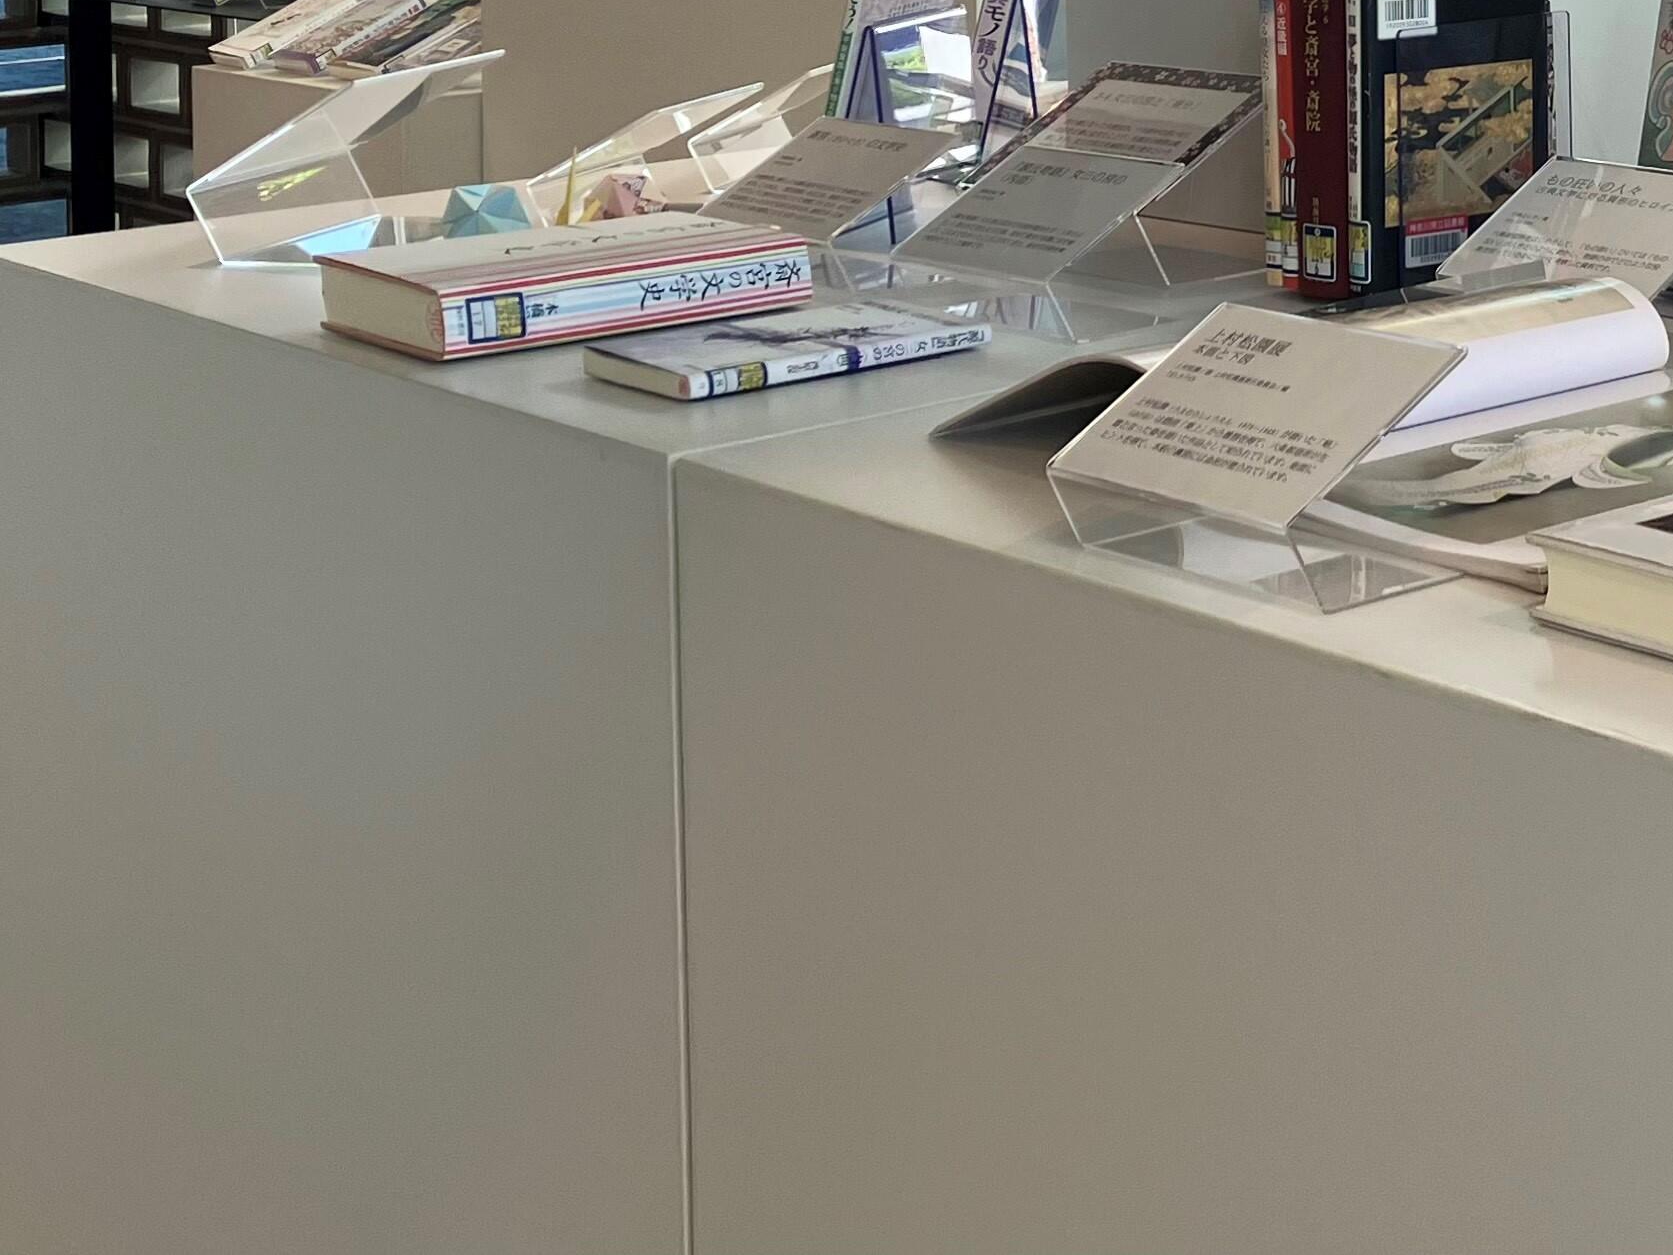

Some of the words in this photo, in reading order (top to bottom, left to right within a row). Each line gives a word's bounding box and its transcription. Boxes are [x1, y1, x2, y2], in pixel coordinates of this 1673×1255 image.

[1203, 328, 1293, 355] 上村松園展
